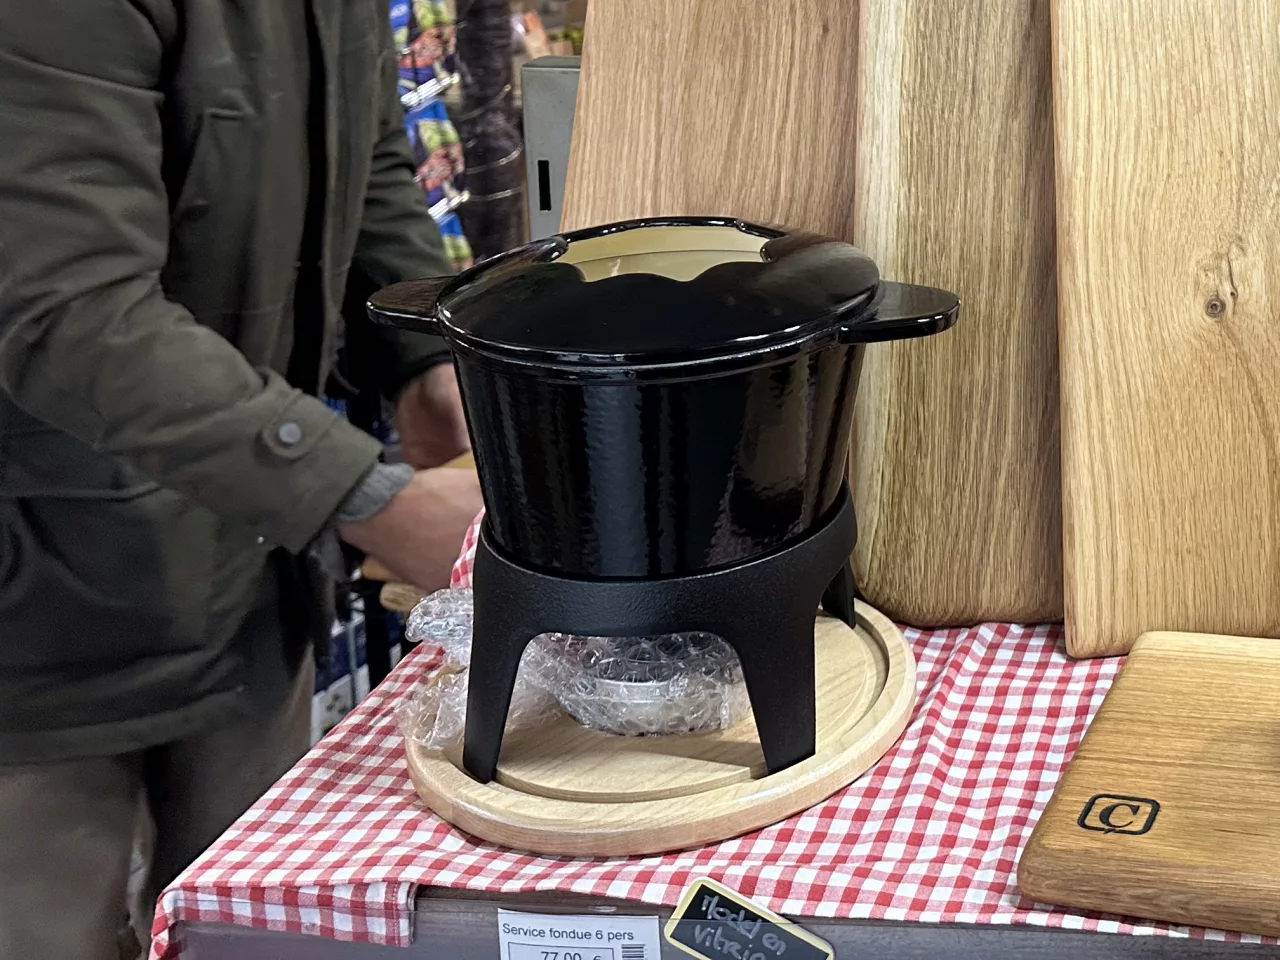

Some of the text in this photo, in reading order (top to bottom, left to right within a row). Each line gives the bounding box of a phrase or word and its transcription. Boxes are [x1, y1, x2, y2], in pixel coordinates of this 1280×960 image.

[502, 923, 634, 943] Service fondue 6 pers
